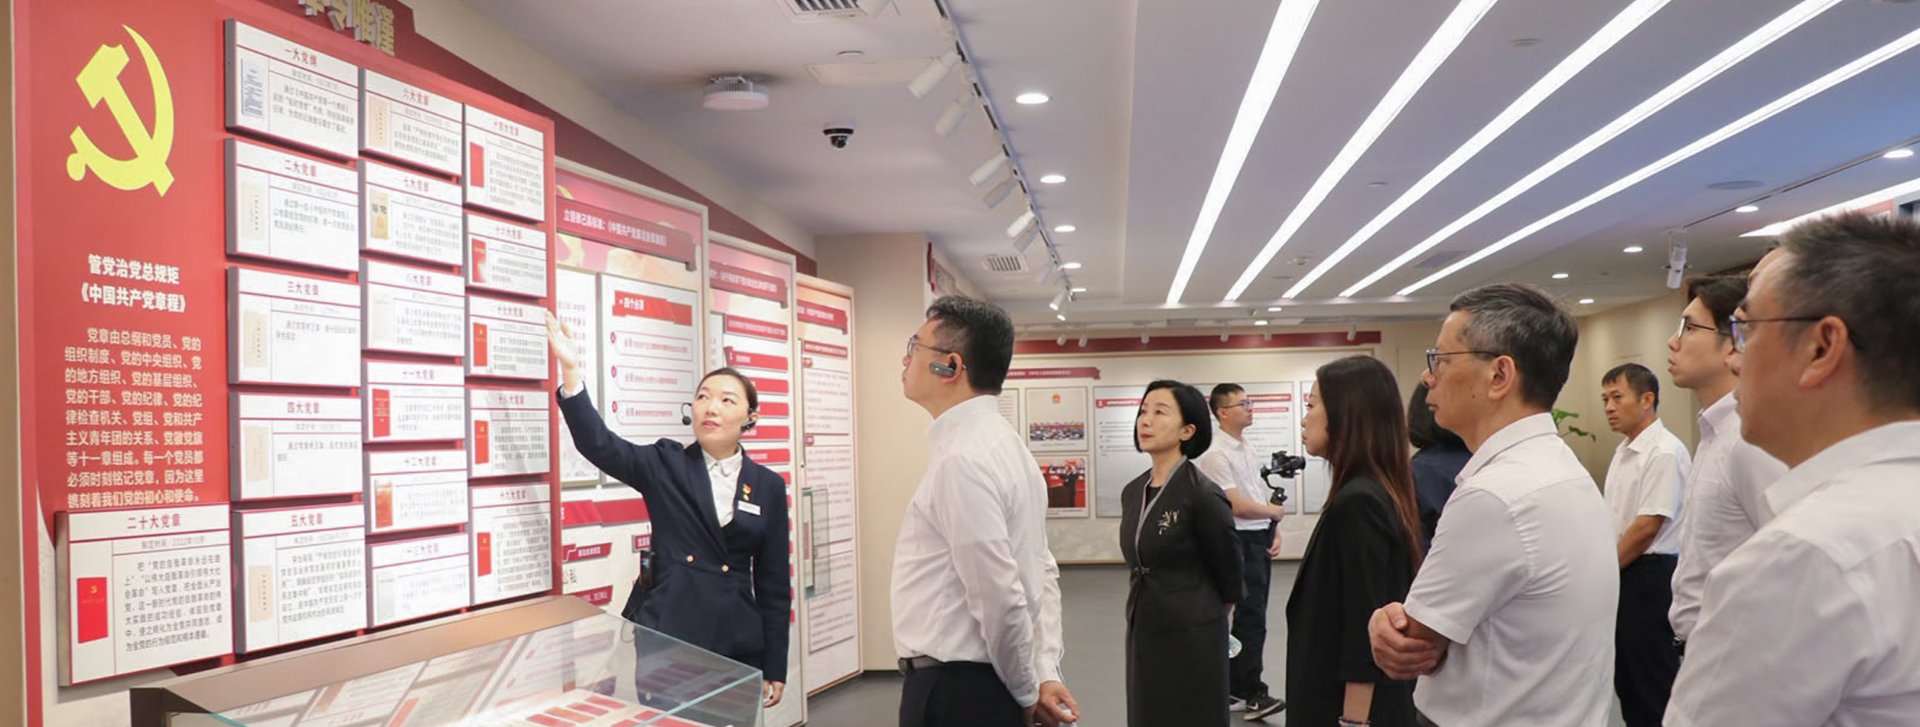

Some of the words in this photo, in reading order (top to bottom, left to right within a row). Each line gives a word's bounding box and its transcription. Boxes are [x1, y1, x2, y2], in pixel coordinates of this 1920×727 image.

[284, 47, 318, 67] 一大党纲
[285, 159, 317, 177] 二大党章
[88, 253, 180, 284] 管党治党总规矩
[81, 282, 186, 313] 《中国共产党章程》
[287, 281, 319, 296] 三大党章
[87, 327, 202, 351] 党章由总纲和党员、党的
[64, 346, 202, 370] 组织制度、党的中央组织、党
[65, 367, 198, 389] 的地方组织、党的基层组织、
[65, 388, 203, 408] 党的干部、党的纪律、党的纪
[287, 401, 320, 414] 四大党章
[66, 410, 203, 427] 律检查机关、党组、党和共产
[66, 430, 204, 446] 主义青年团的关系、党徽党旗
[66, 450, 204, 467] 等十一章组成。每一个党员都
[67, 469, 204, 487] 必须时刻铭记党章，因为这里
[68, 488, 199, 509] 镌刻着我们党的初心和使命。
[127, 513, 181, 530] 二十大党章
[291, 512, 324, 527] 五大党章
